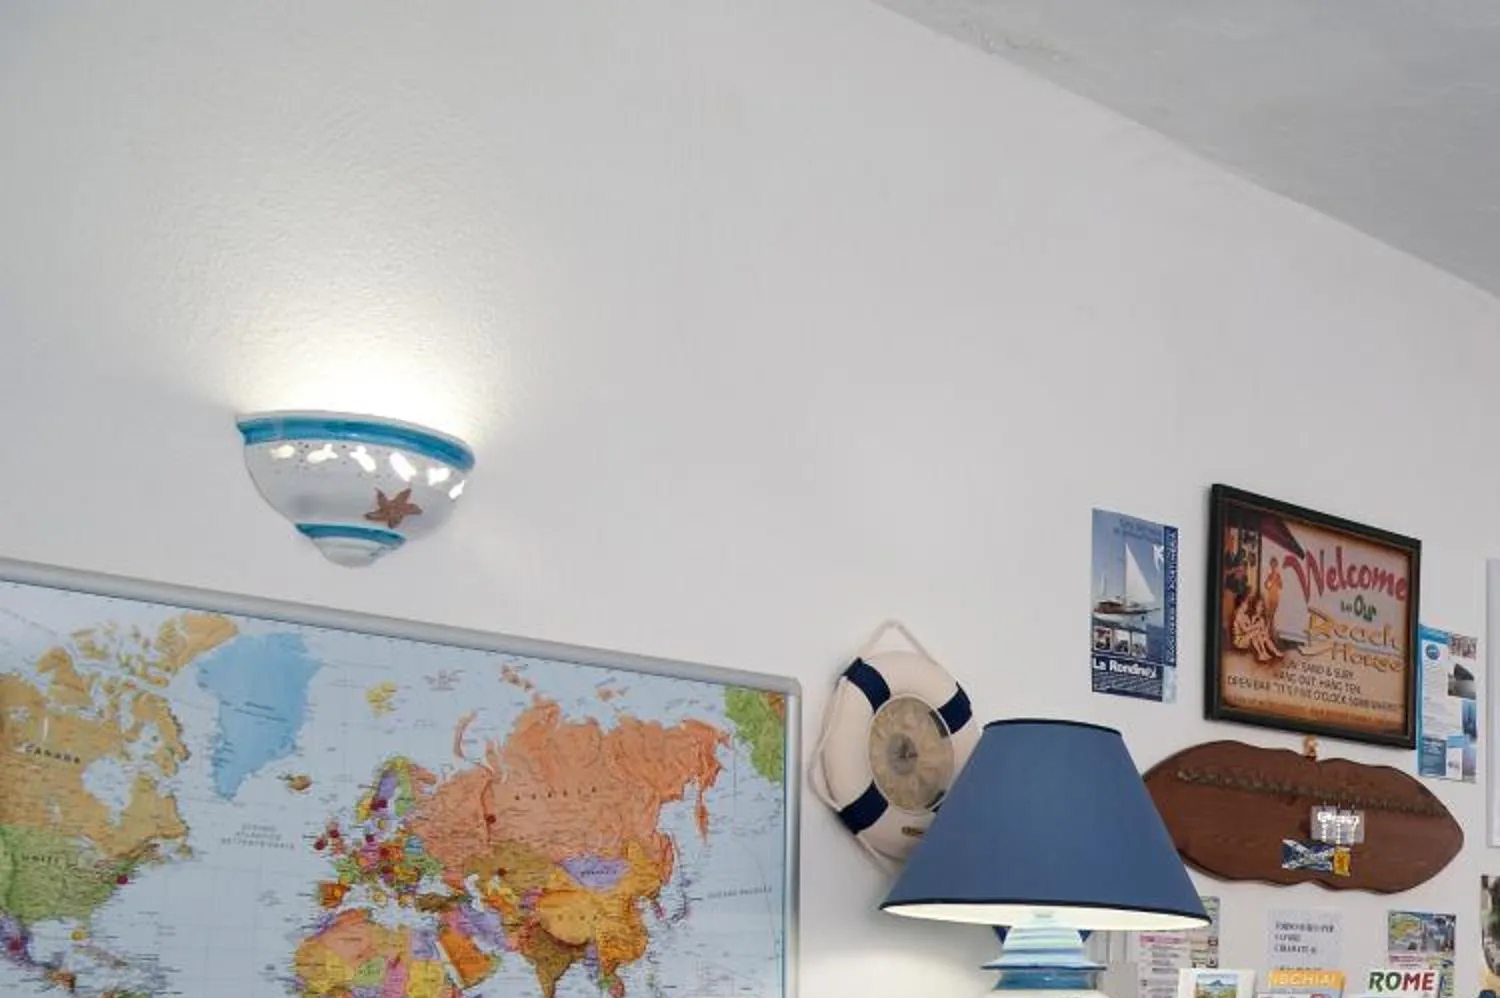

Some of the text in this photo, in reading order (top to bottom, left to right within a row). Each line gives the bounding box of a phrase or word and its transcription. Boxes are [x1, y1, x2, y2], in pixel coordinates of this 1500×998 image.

[1283, 545, 1407, 604] Welcome
[1353, 594, 1377, 621] Our
[1307, 607, 1401, 650] Beach
[1299, 641, 1404, 673] House
[1368, 971, 1437, 992] ROME
